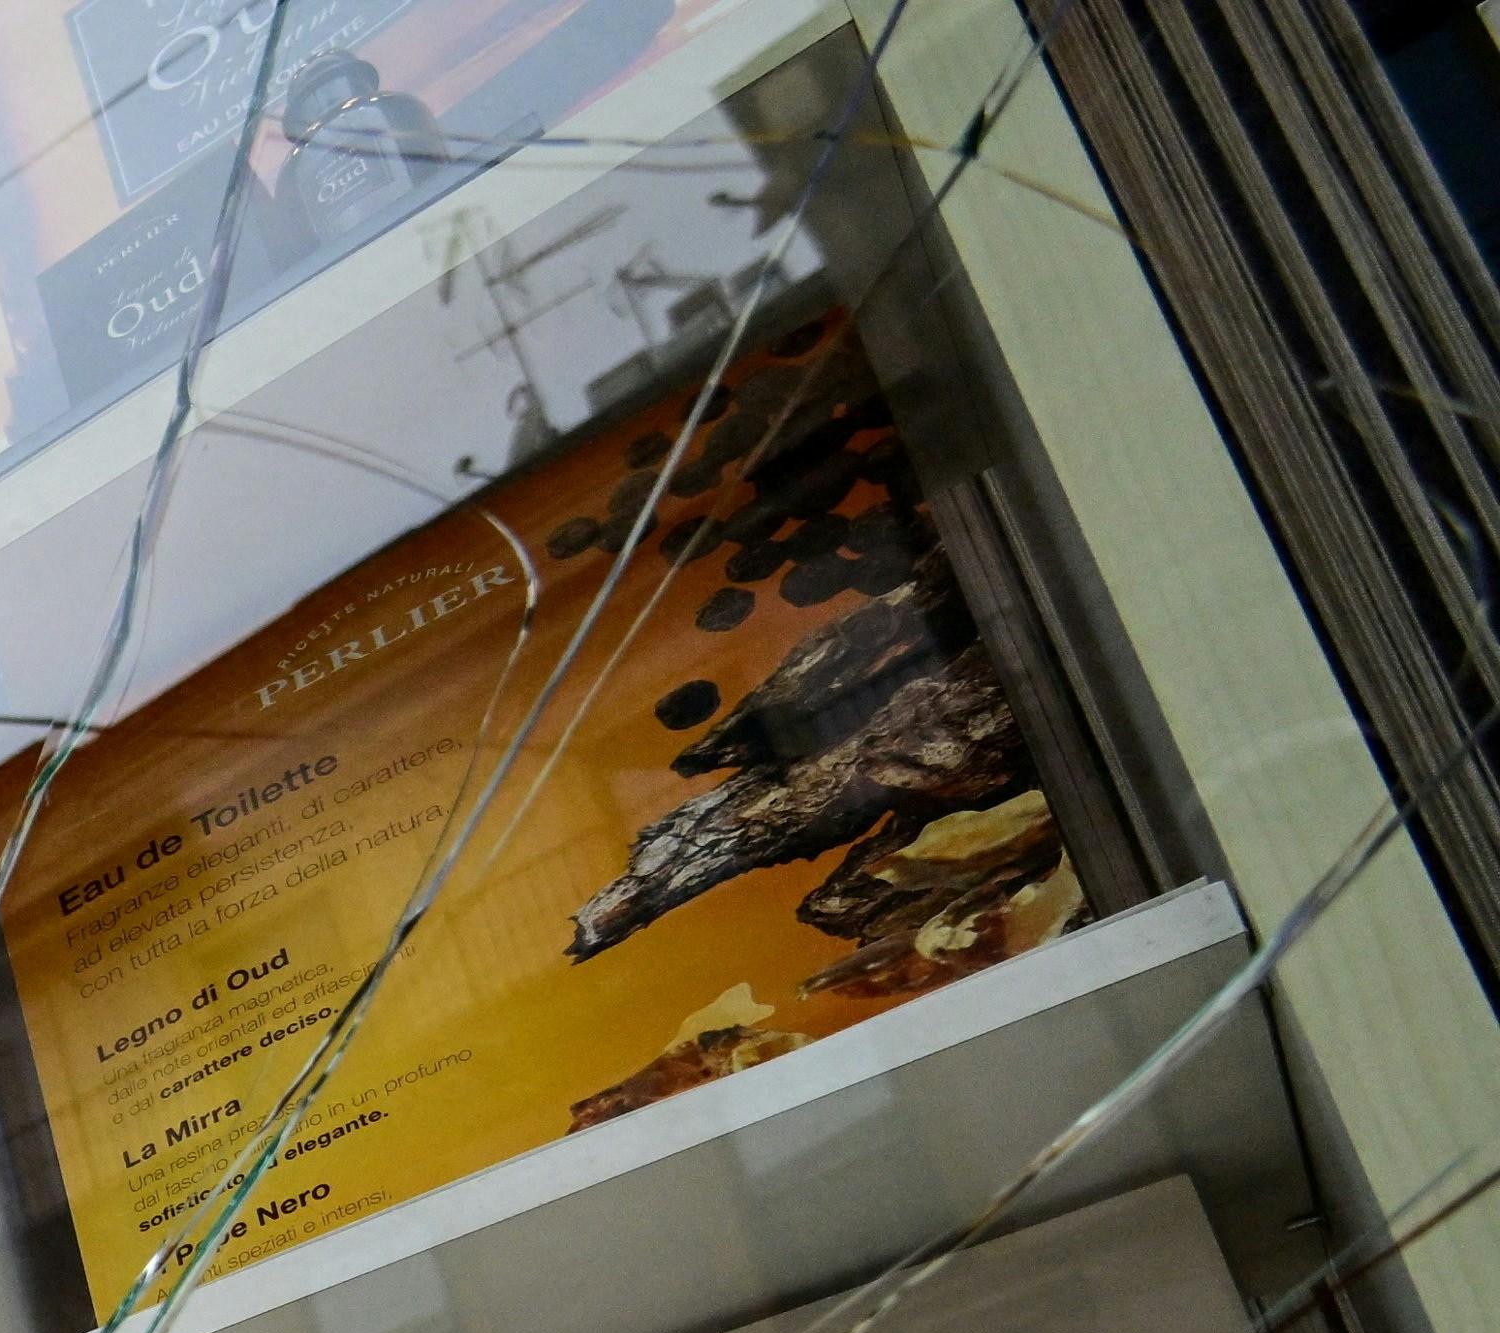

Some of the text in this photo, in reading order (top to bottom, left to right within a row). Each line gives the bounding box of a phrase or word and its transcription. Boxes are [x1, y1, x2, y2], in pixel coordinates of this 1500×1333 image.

[317, 157, 369, 204] Oud
[107, 256, 206, 338] Oud
[254, 565, 516, 711] PERLIER
[277, 561, 475, 671] RICETTE NATURALI
[57, 751, 339, 917] Eau de Toilette
[65, 736, 464, 949] Fragranze eleganti, di carattere,
[73, 818, 355, 974] ad elevata persistenza,
[79, 801, 452, 1000] con tutta la forza della natura,
[96, 947, 290, 1063] Legno di Oud
[102, 961, 335, 1086] Una fragranza magnetica,
[107, 946, 416, 1107] dalle note orientali ed affascinnti
[112, 1005, 340, 1125] e dal carattere deciso.
[121, 1097, 243, 1169] La Mirra
[128, 1166, 166, 1193] Una
[169, 1136, 224, 1174] resina
[133, 1048, 474, 1214] dal fascino in un profumo
[284, 1110, 390, 1161] elegante.
[226, 1187, 393, 1274] speziati e intensi,
[255, 1182, 332, 1227] Nero
